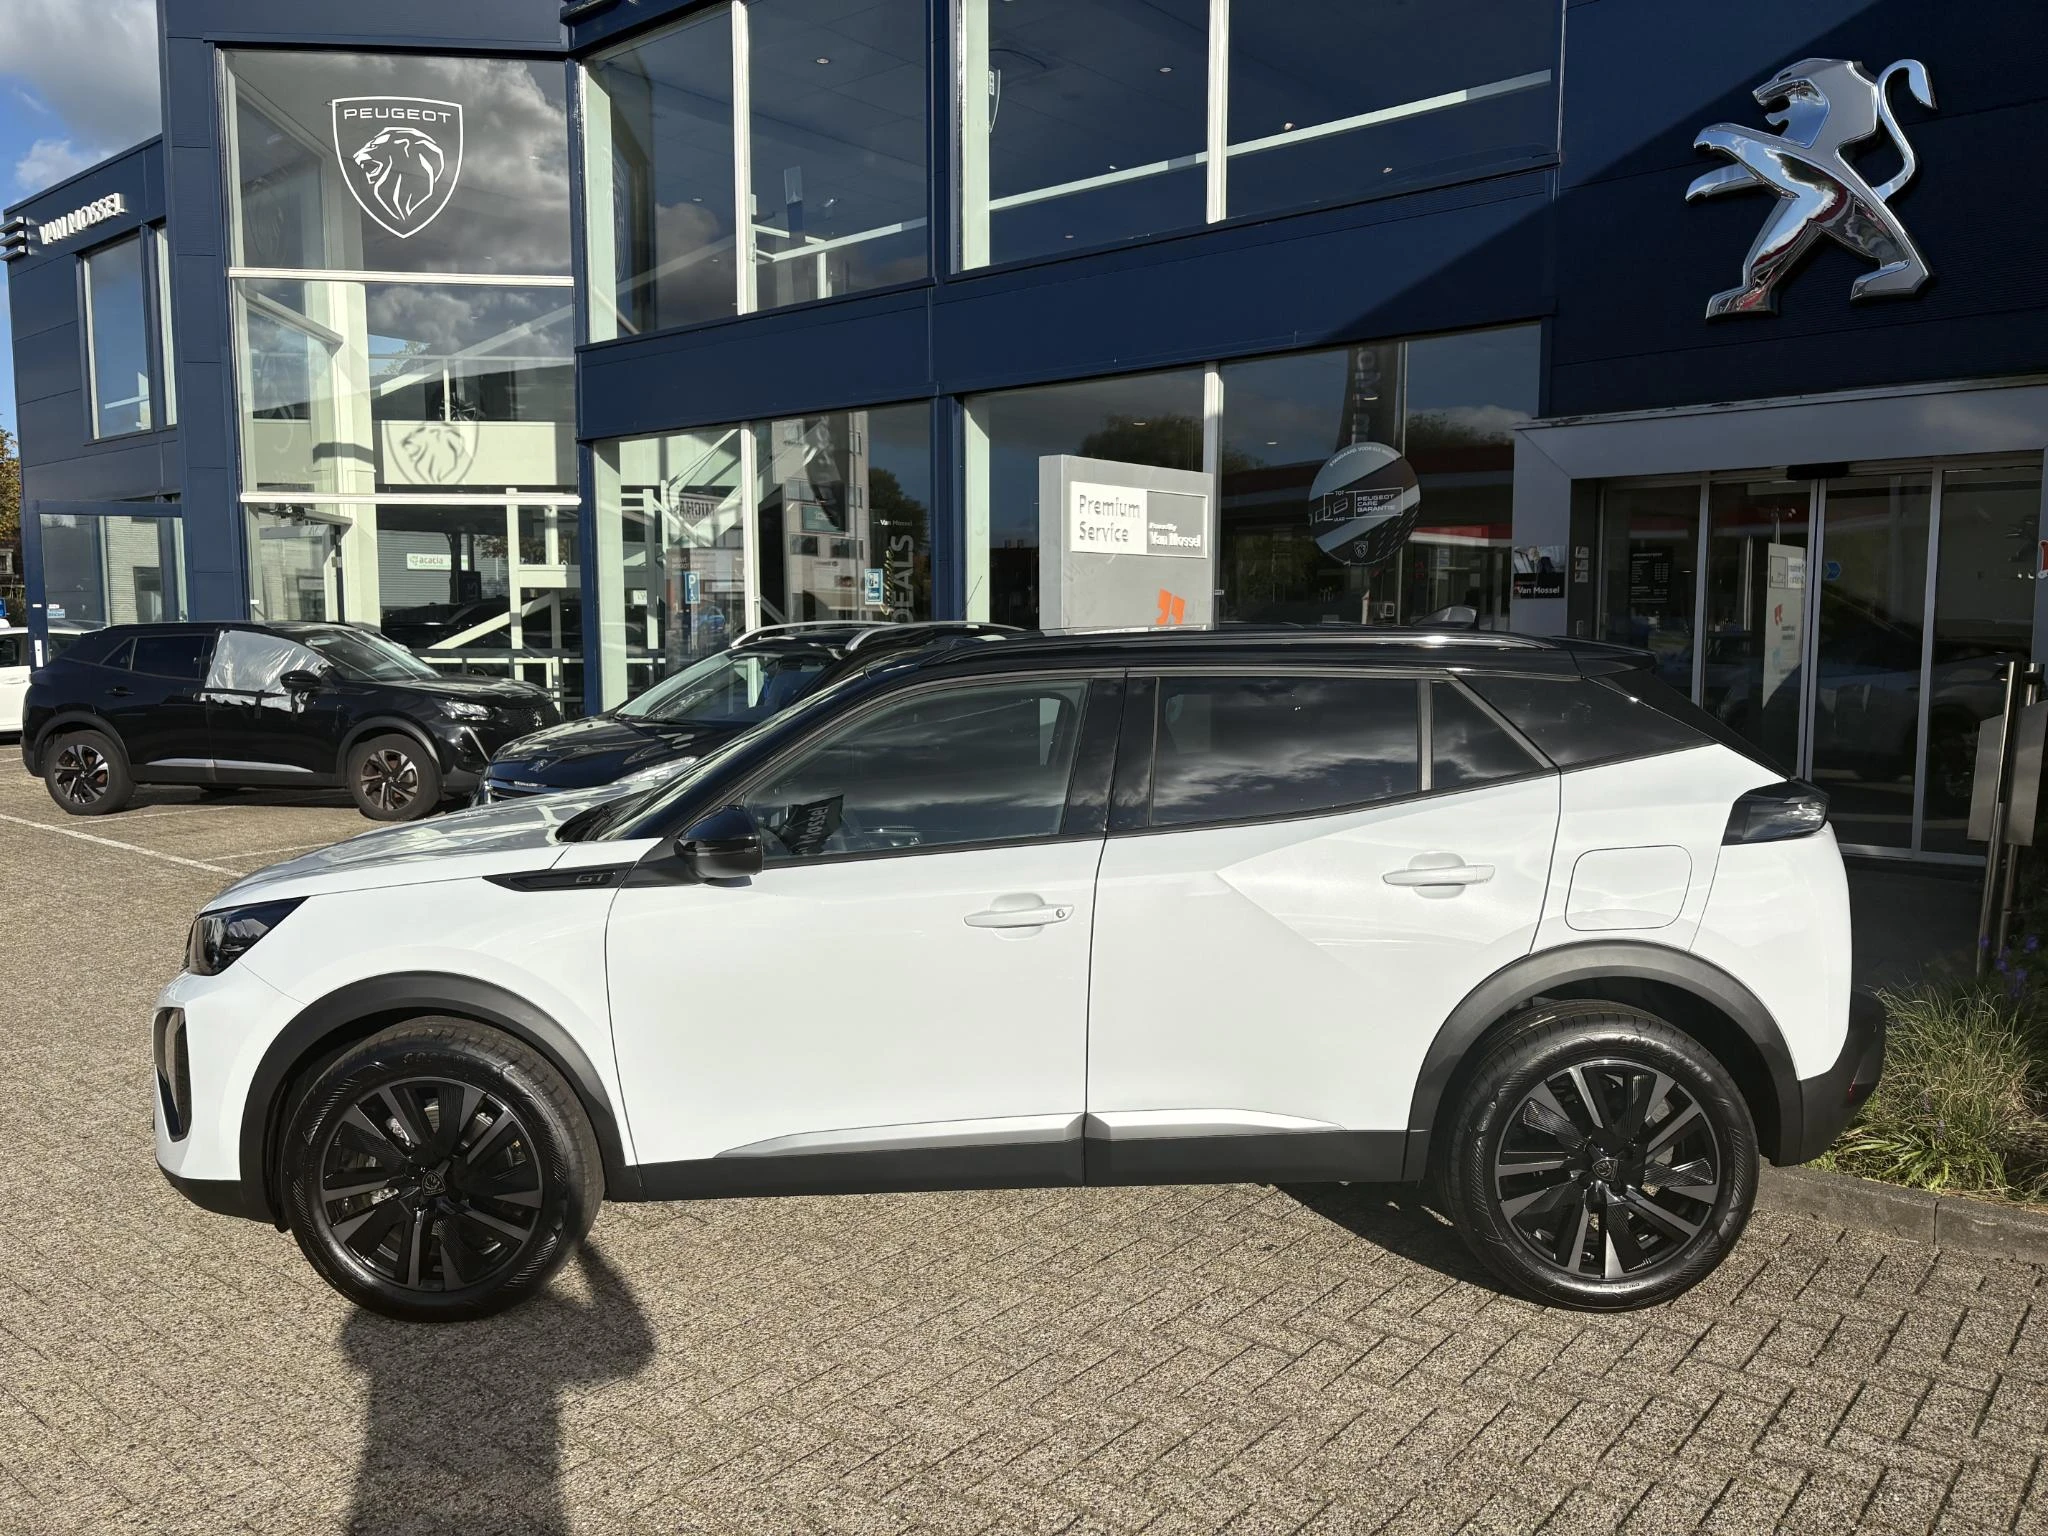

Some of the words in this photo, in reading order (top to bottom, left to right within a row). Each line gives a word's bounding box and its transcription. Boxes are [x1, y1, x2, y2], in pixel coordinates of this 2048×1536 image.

[343, 107, 451, 123] PEUGEOT
[39, 216, 68, 245] VAN
[67, 193, 126, 234] MOSSEL
[1357, 493, 1395, 502] PEUGEOT
[1079, 494, 1140, 518] Premium
[1357, 505, 1397, 514] GARANTIE
[1079, 521, 1129, 542] Service
[1150, 531, 1168, 546] Van
[1168, 532, 1201, 548] Mossel
[1519, 586, 1532, 594] Van
[1533, 585, 1560, 594] Mossel
[575, 873, 605, 884] GT
